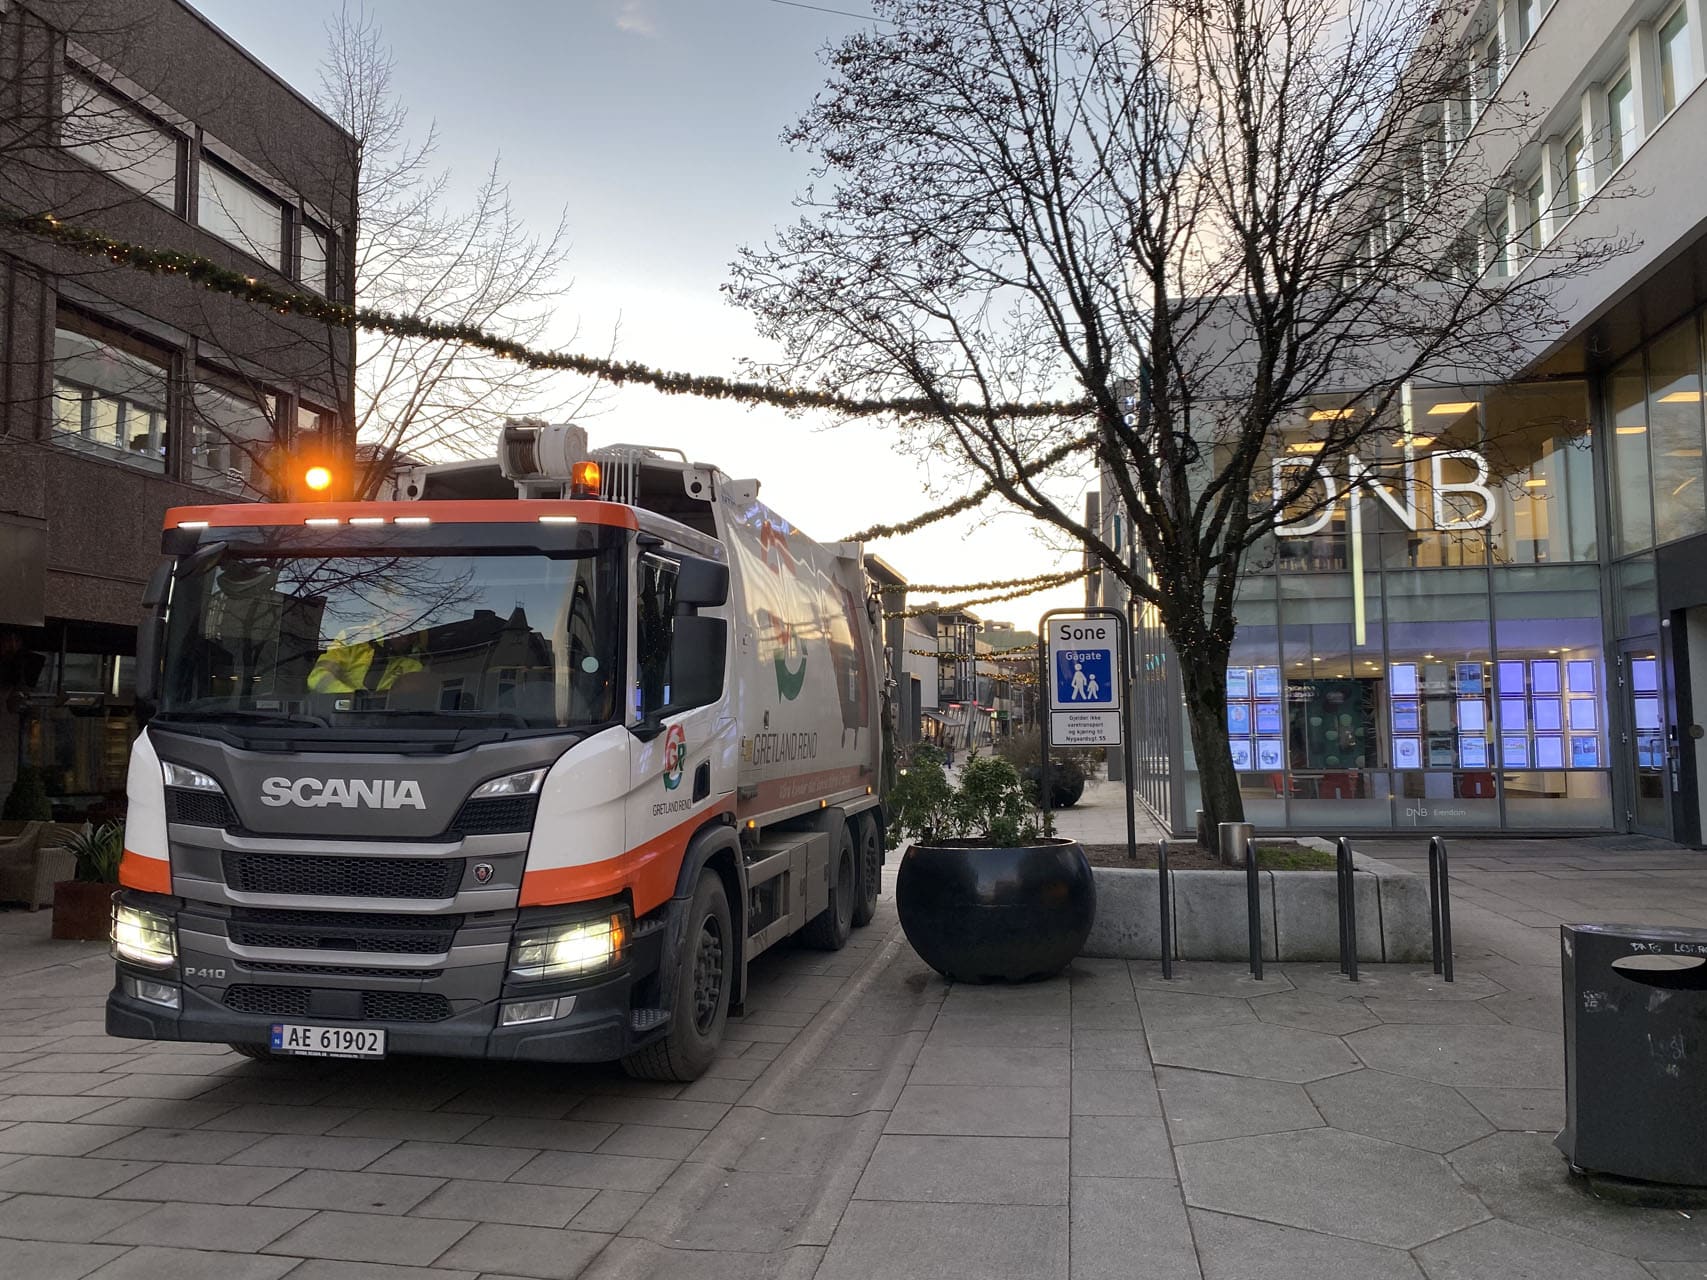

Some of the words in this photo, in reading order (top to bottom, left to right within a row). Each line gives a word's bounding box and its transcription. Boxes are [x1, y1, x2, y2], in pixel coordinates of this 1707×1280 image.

[1272, 450, 1497, 537] DNB
[1060, 624, 1106, 641] Sone
[1065, 651, 1102, 662] Gågate
[798, 731, 818, 762] RENO
[260, 776, 427, 810] SCANIA
[1406, 807, 1428, 817] DNB
[184, 967, 195, 977] P
[197, 968, 226, 979] 410
[288, 1027, 312, 1047] AE
[320, 1030, 378, 1052] 61902
